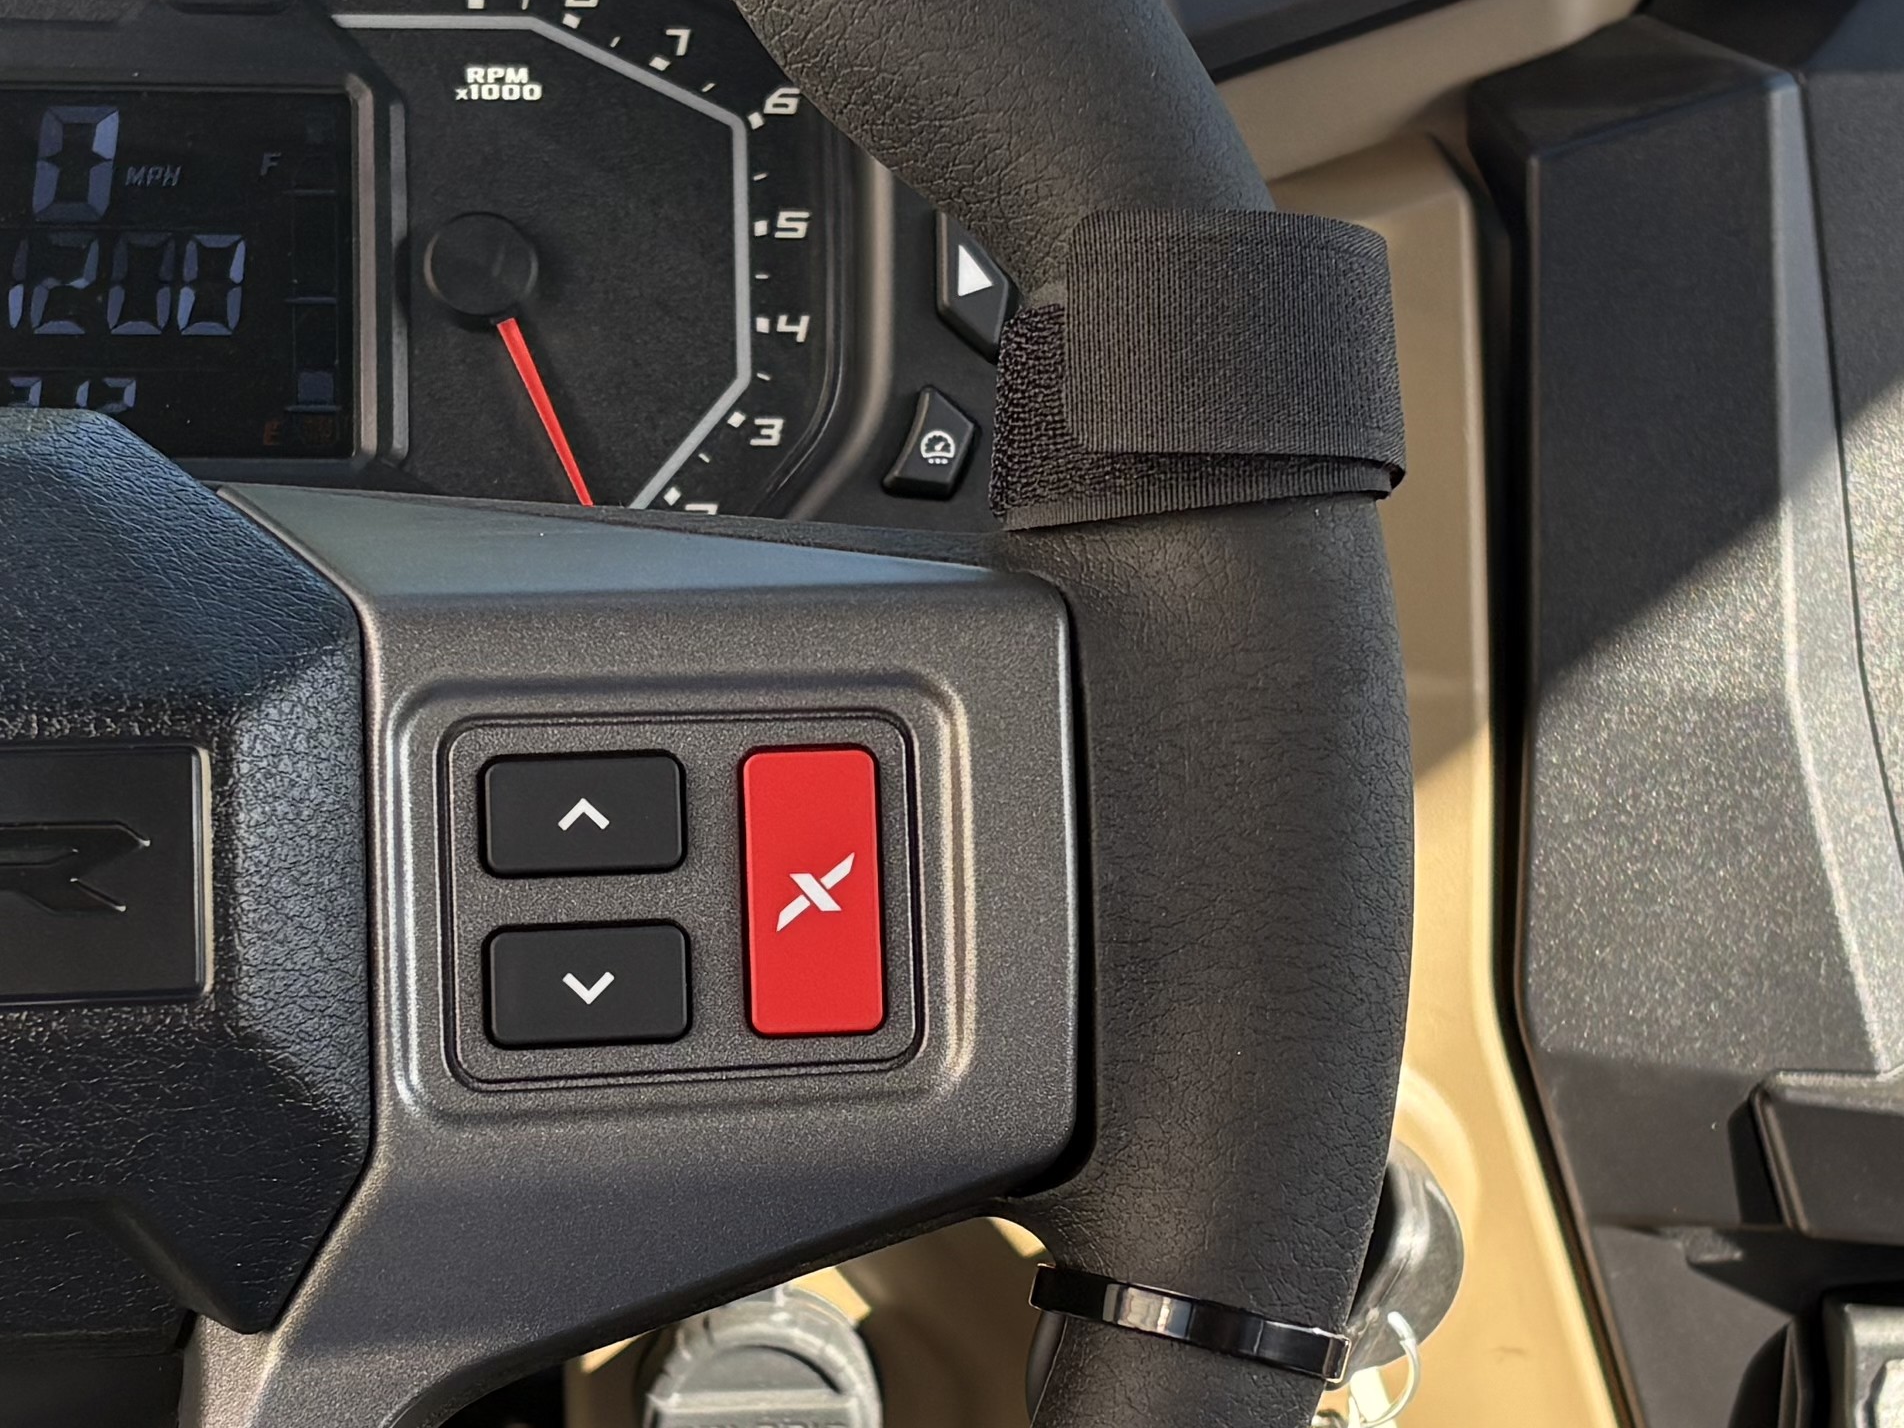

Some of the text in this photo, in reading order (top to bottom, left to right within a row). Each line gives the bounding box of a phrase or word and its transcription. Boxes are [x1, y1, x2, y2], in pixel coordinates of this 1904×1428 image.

[666, 29, 692, 56] 7
[466, 67, 529, 85] RPM
[454, 83, 543, 102] x1000
[763, 88, 800, 116] 6
[32, 105, 183, 222] 0 MPH
[259, 153, 283, 178] F
[775, 211, 811, 239] 5
[7, 233, 248, 336] 1200
[776, 315, 810, 343] 4
[749, 419, 784, 446] 3
